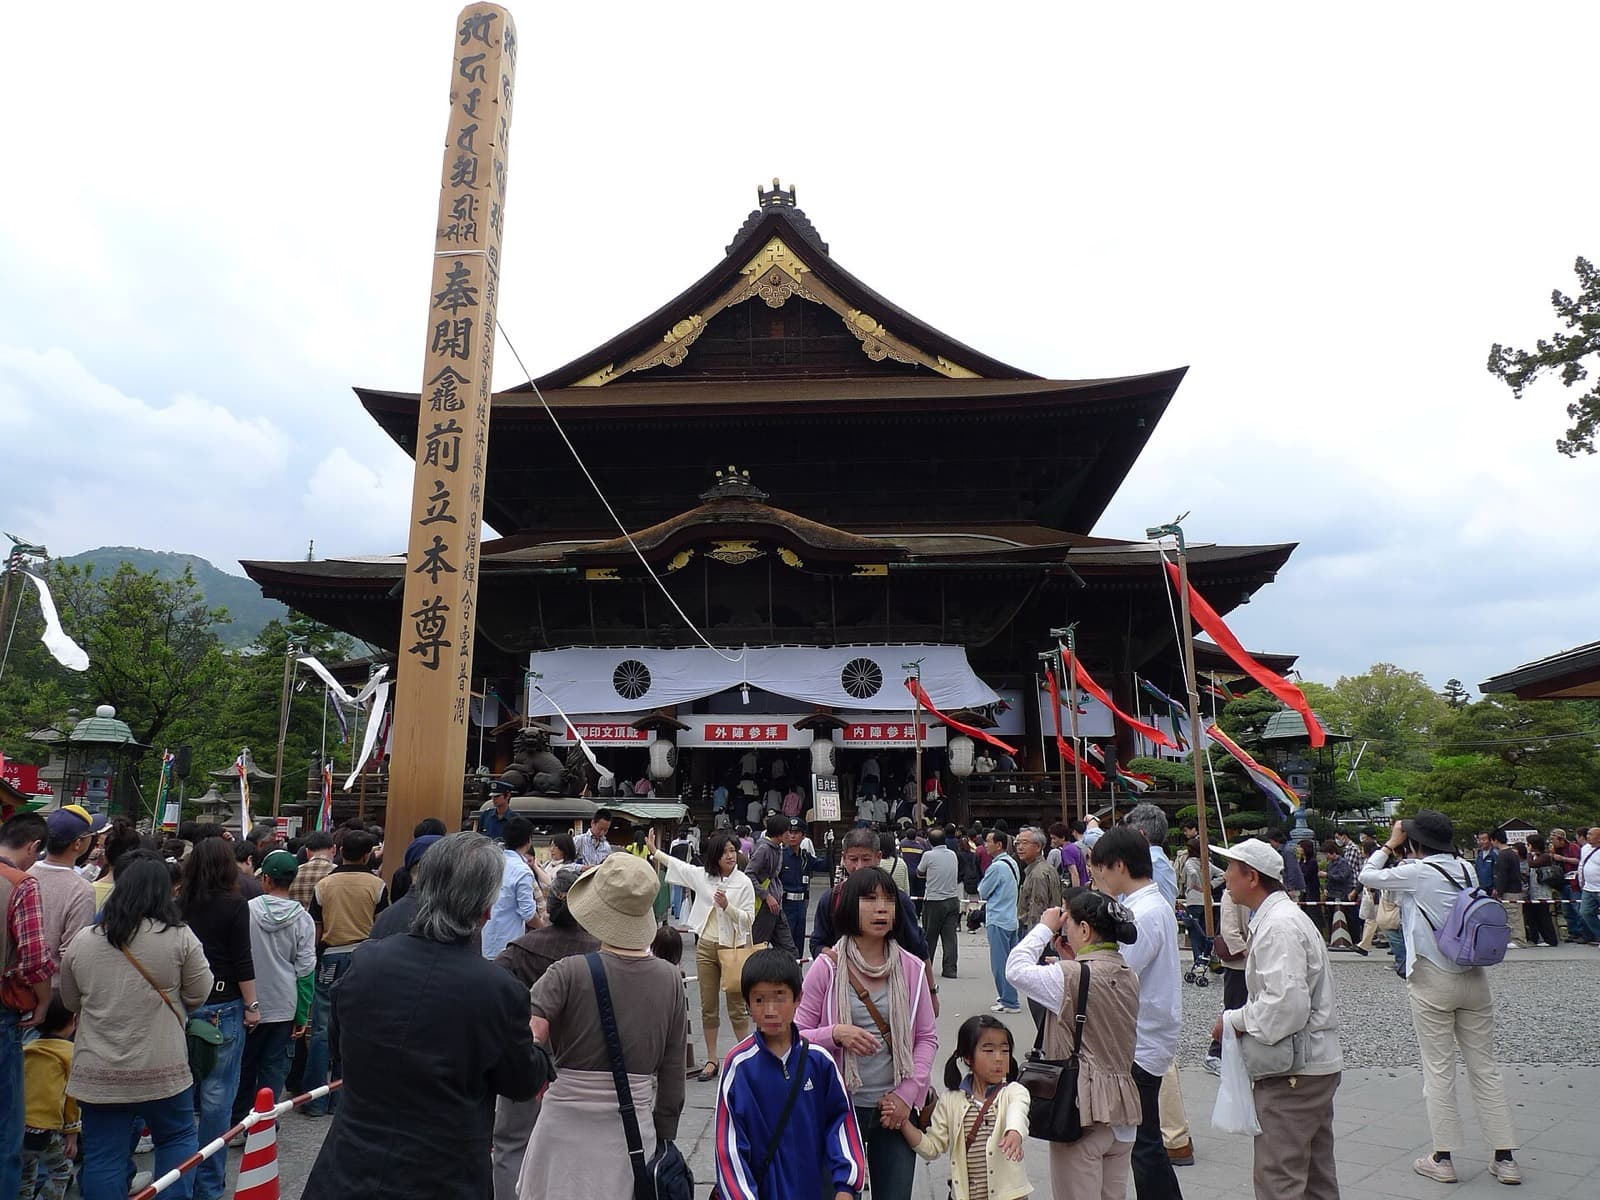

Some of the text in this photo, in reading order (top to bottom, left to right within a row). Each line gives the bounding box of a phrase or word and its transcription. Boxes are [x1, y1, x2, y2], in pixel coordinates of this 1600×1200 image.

[715, 727, 778, 739] 外陣参拝
[853, 726, 916, 738] 内陣参拝
